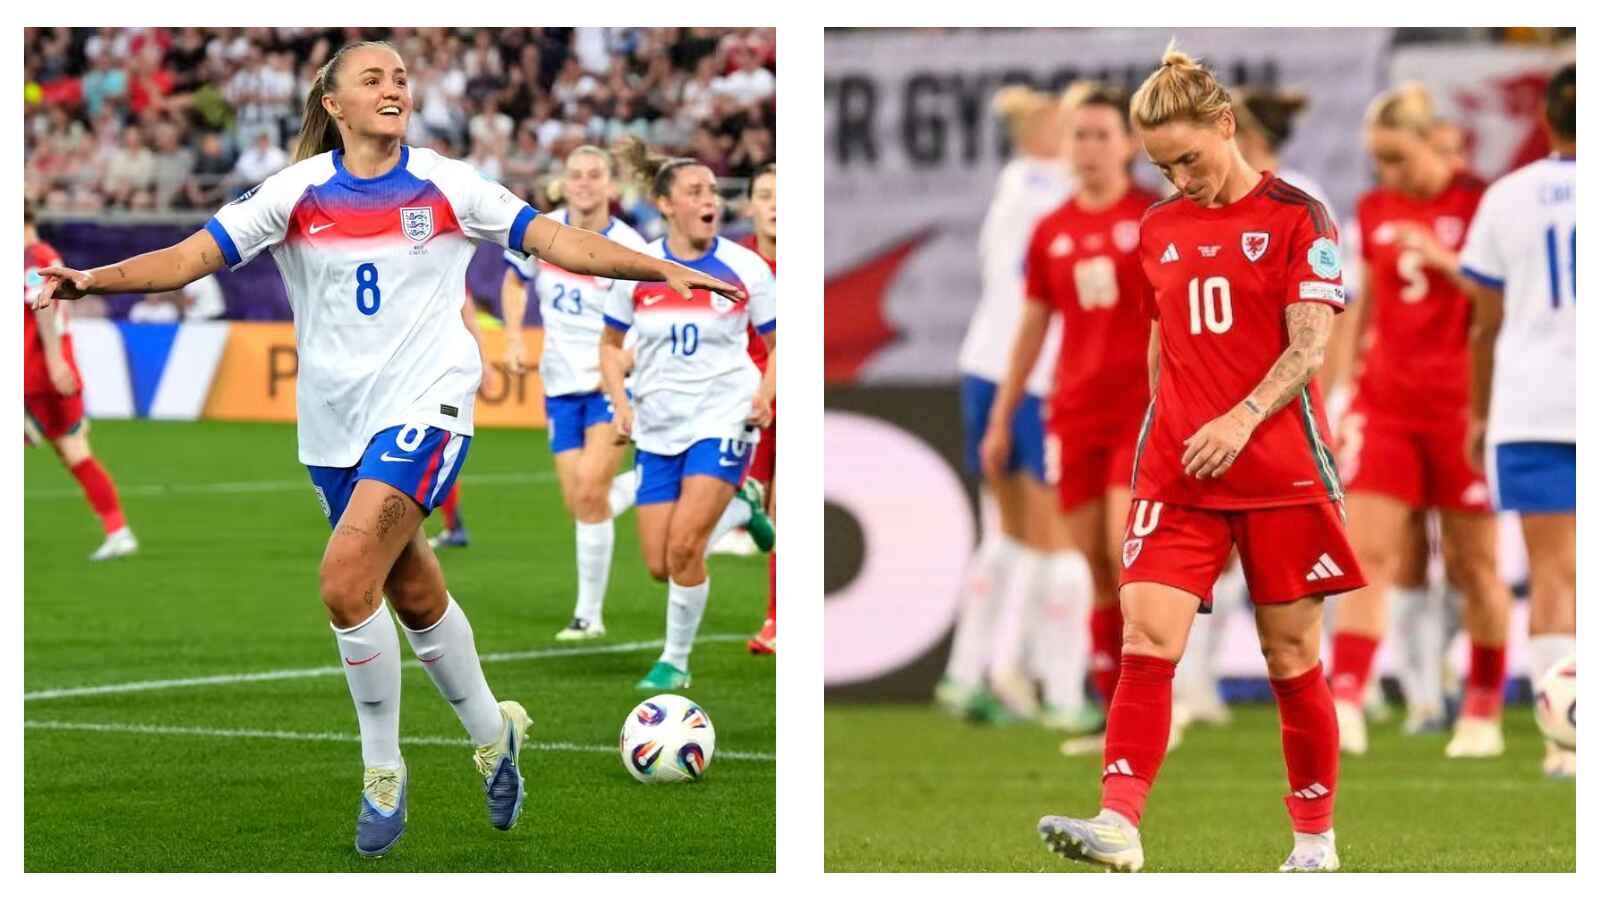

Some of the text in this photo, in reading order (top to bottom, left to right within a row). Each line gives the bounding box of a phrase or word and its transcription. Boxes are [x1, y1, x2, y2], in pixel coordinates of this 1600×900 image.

[355, 262, 381, 316] 8
[1188, 275, 1233, 335] 10
[670, 322, 699, 356] 10
